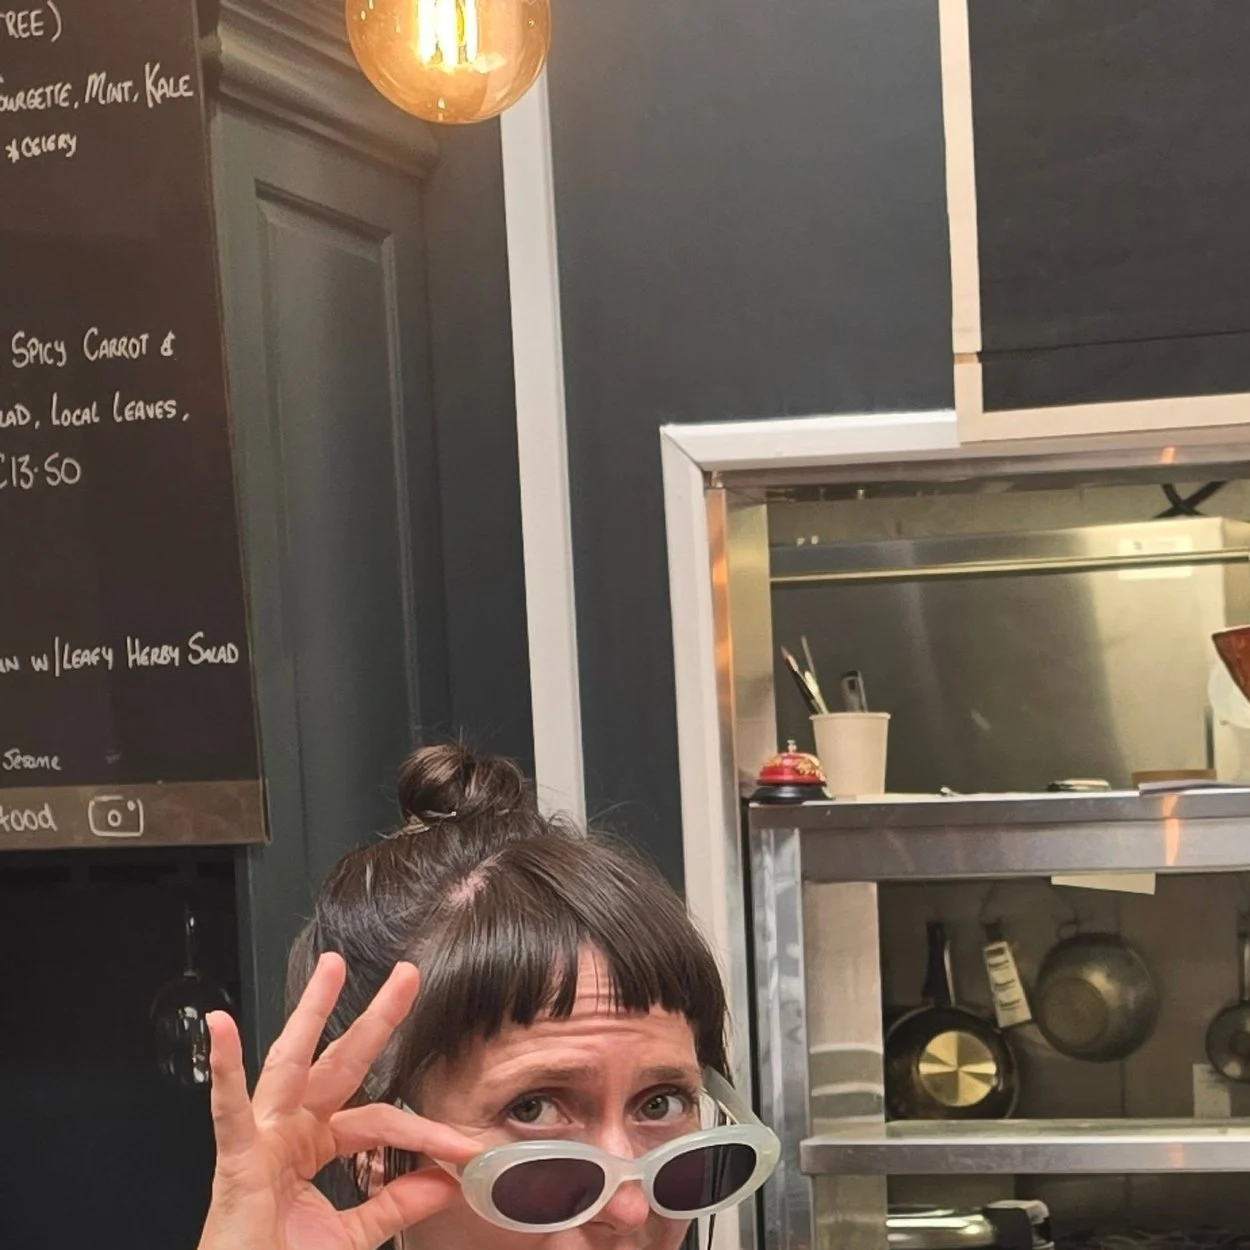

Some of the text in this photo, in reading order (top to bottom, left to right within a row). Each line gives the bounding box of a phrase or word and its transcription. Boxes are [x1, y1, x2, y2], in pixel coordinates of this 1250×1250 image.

[0, 0, 61, 42] REE)
[0, 74, 79, 112] OURGETTE,
[144, 62, 193, 108] KALE
[11, 331, 67, 368] SPICY
[83, 327, 149, 361] CARROT
[51, 392, 100, 427] LOCAL
[127, 636, 179, 669] HERBY
